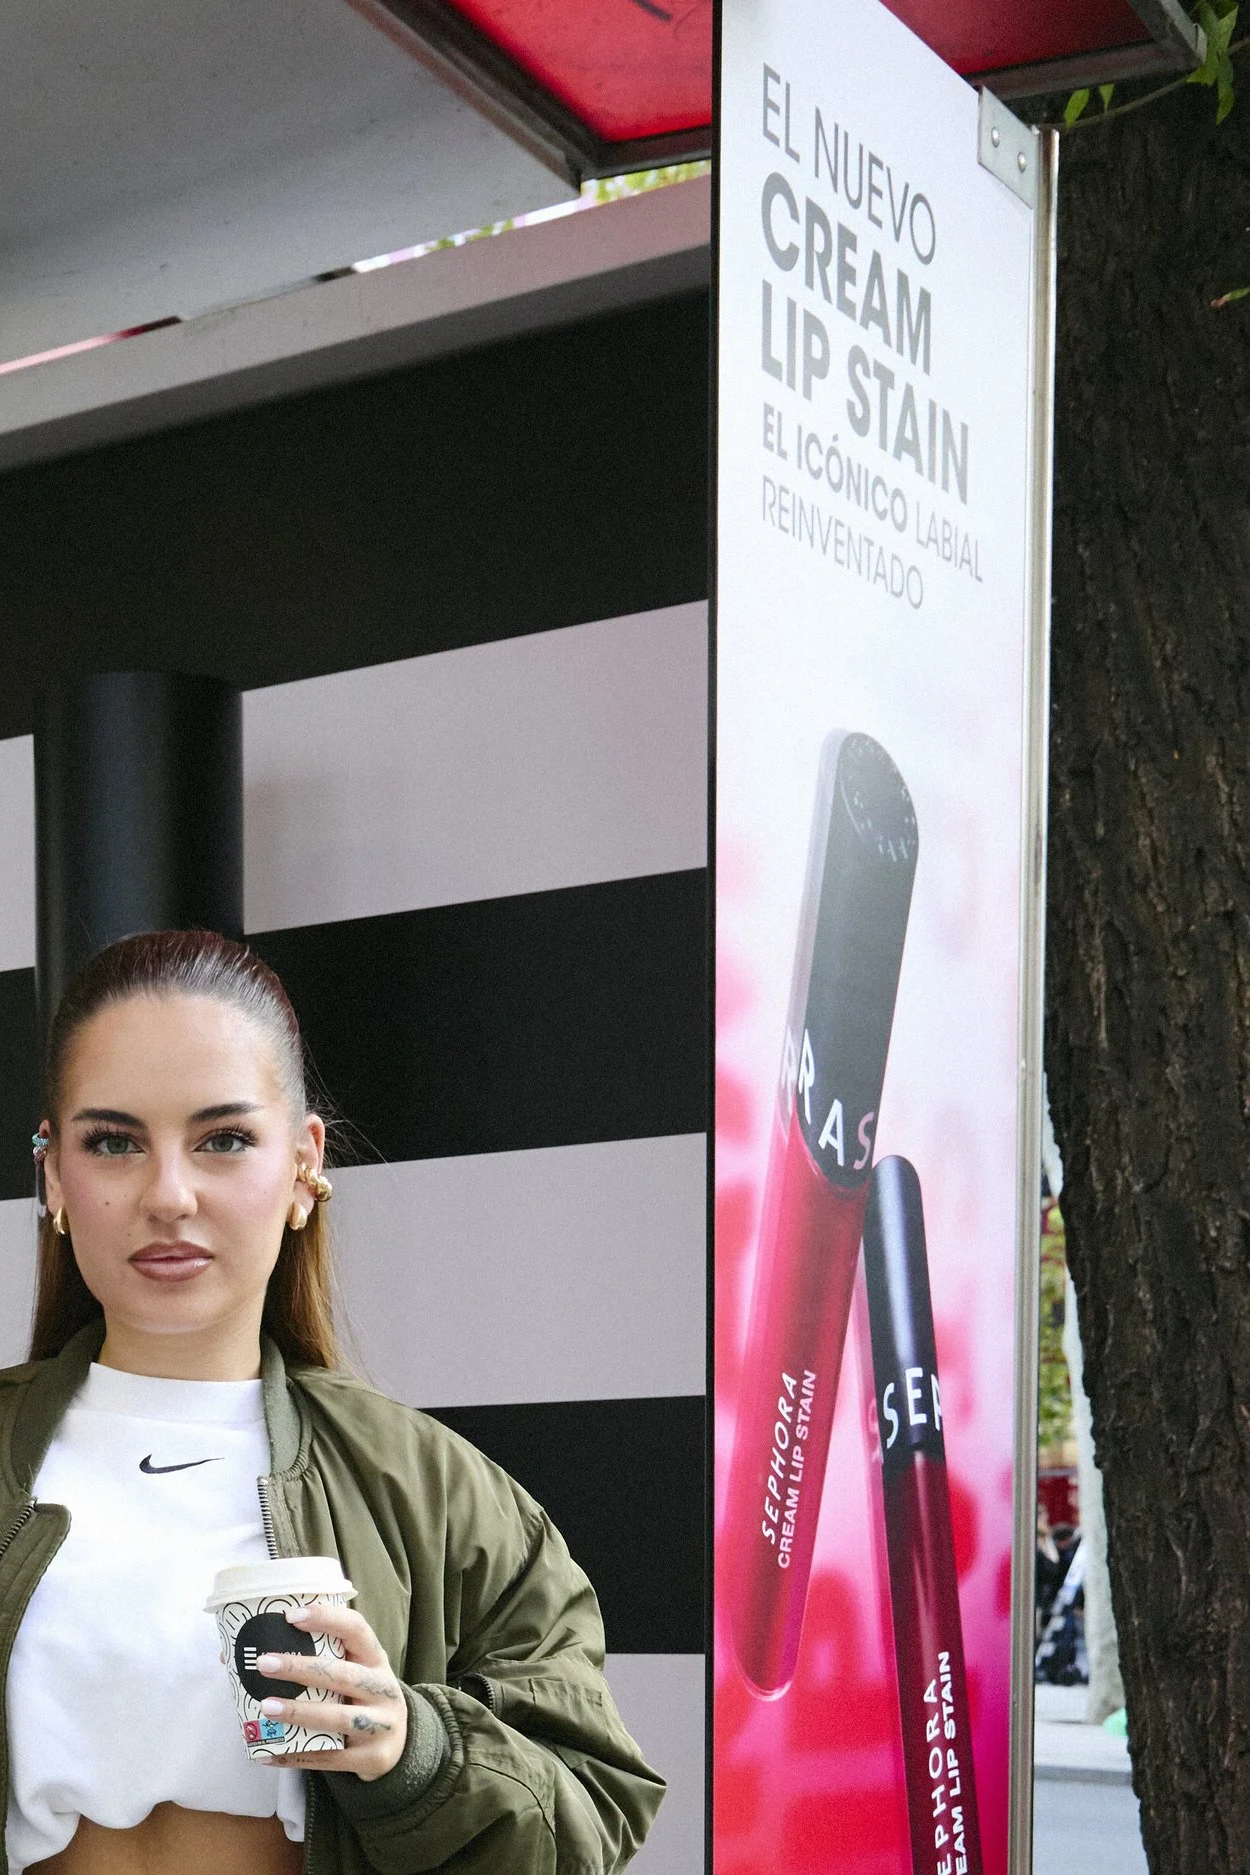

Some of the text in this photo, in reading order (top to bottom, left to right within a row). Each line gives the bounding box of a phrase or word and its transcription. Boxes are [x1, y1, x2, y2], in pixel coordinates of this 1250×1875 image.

[762, 61, 936, 266] EL NUEVO
[761, 170, 932, 377] CREAM
[760, 278, 969, 505] LIP STAIN
[762, 401, 984, 584] EL ICÓNICO LABIAL
[762, 473, 924, 611] REINVENTADO
[762, 1371, 798, 1546] SEPHORA
[777, 1369, 817, 1569] CREAM LIP STAIN
[938, 1651, 956, 1739] STAIN
[947, 1748, 961, 1797] LIP
